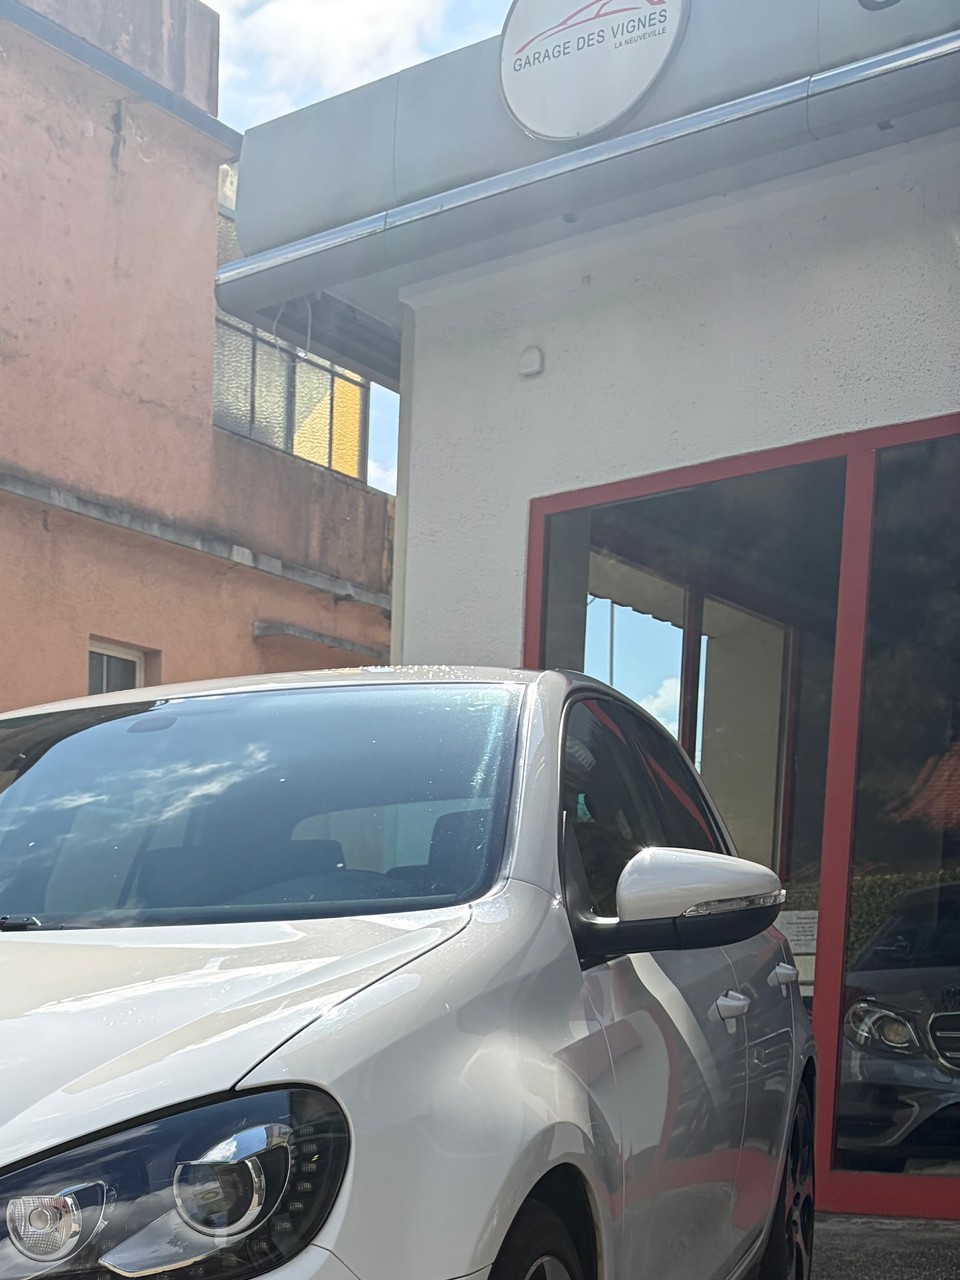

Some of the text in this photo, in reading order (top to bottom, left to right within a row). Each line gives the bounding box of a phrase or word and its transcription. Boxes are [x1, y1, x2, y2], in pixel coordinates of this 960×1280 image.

[513, 8, 668, 72] GARAGE DES VIGNES
[614, 27, 667, 49] LA NEUVEVILLE
